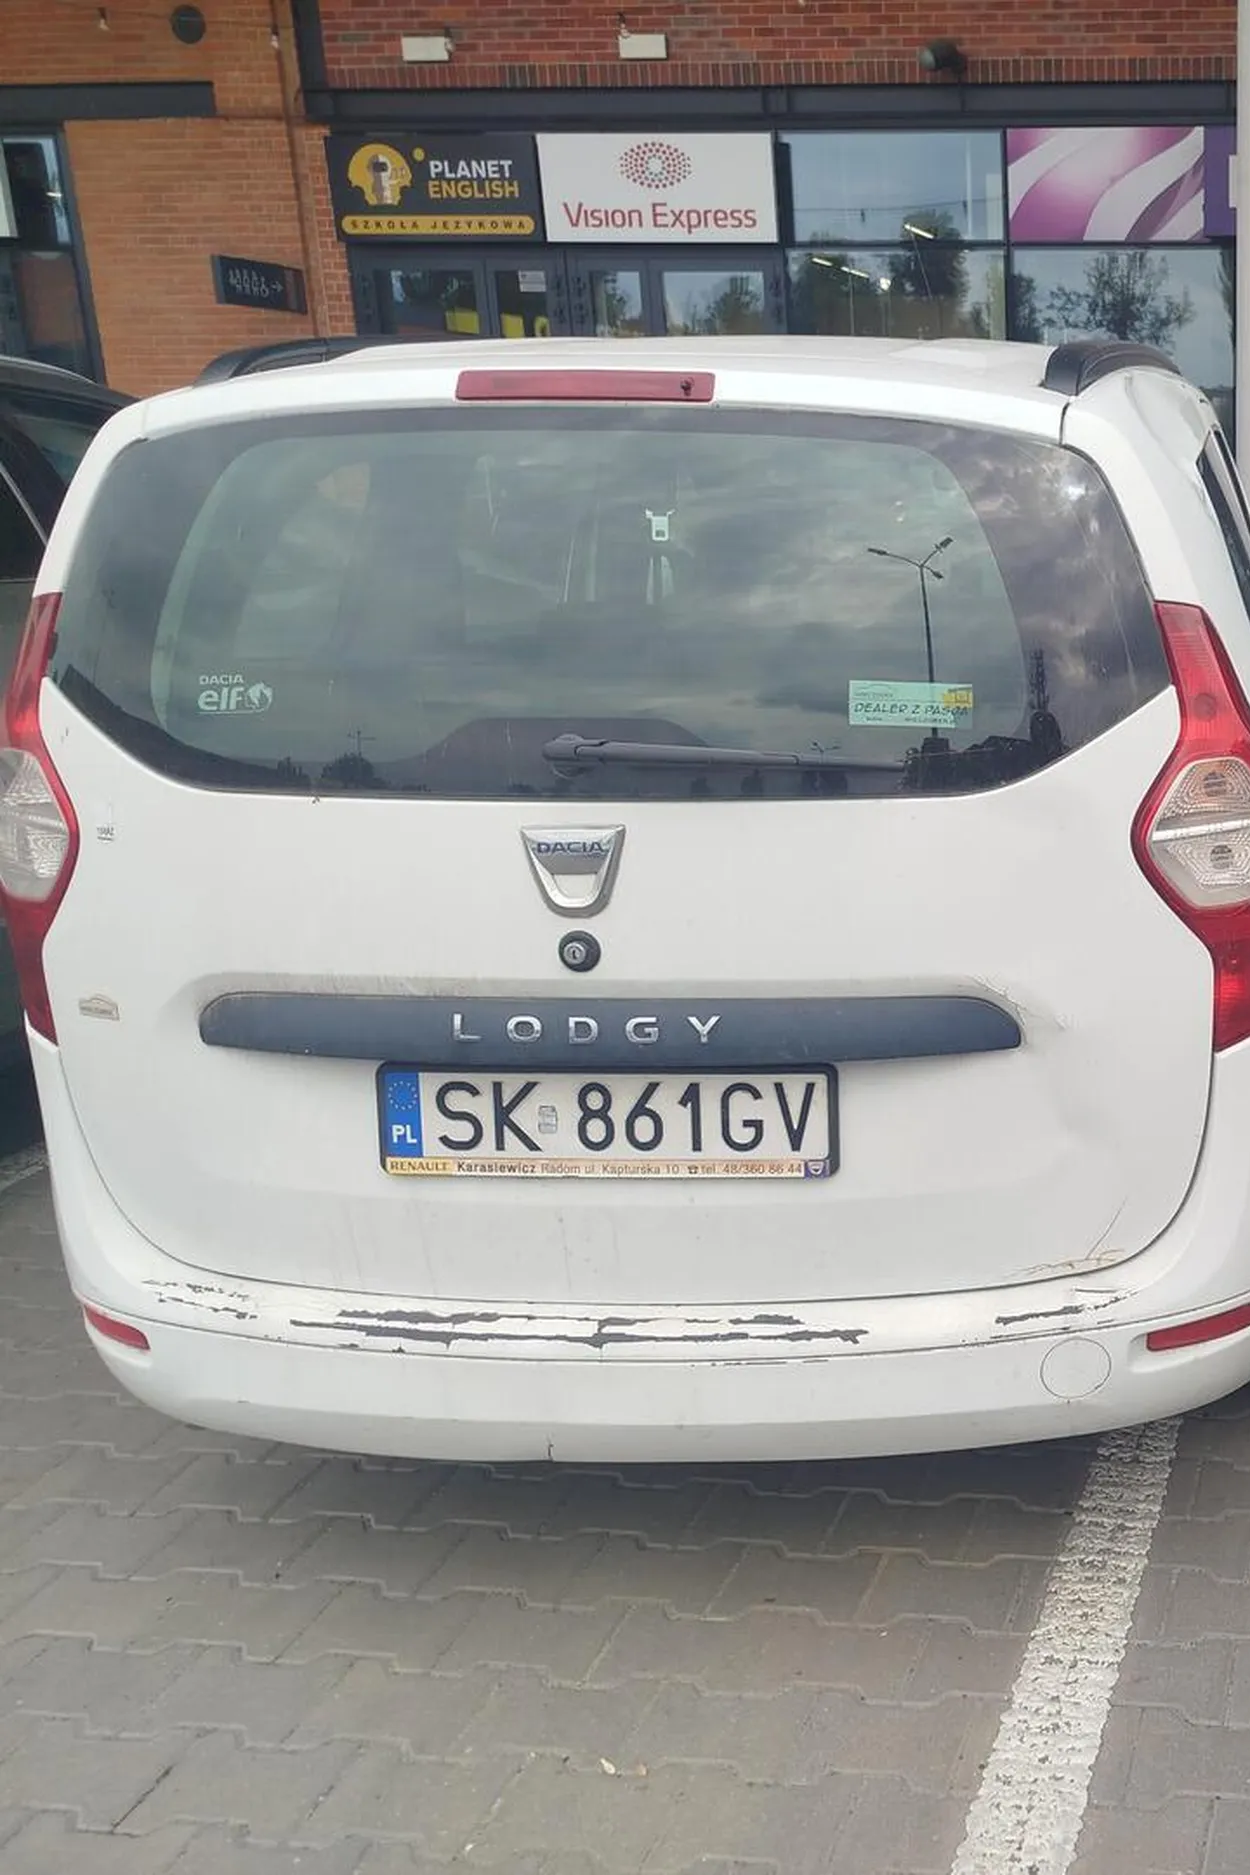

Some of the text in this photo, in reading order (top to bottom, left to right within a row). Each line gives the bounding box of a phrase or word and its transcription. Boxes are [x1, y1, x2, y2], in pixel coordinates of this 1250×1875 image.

[429, 160, 512, 178] PLANET
[428, 180, 519, 198] ENGLISH
[563, 201, 757, 234] Vision Express
[199, 674, 244, 685] DACIA
[198, 686, 244, 711] elf
[854, 702, 908, 715] DEALER
[911, 704, 921, 715] Z
[537, 841, 605, 854] DACIA
[452, 1013, 722, 1045] LODGY
[392, 1081, 817, 1153] PL SK 861GV
[390, 1161, 449, 1172] RENAULT
[541, 1162, 581, 1175] Radom
[666, 1163, 680, 1174] 10
